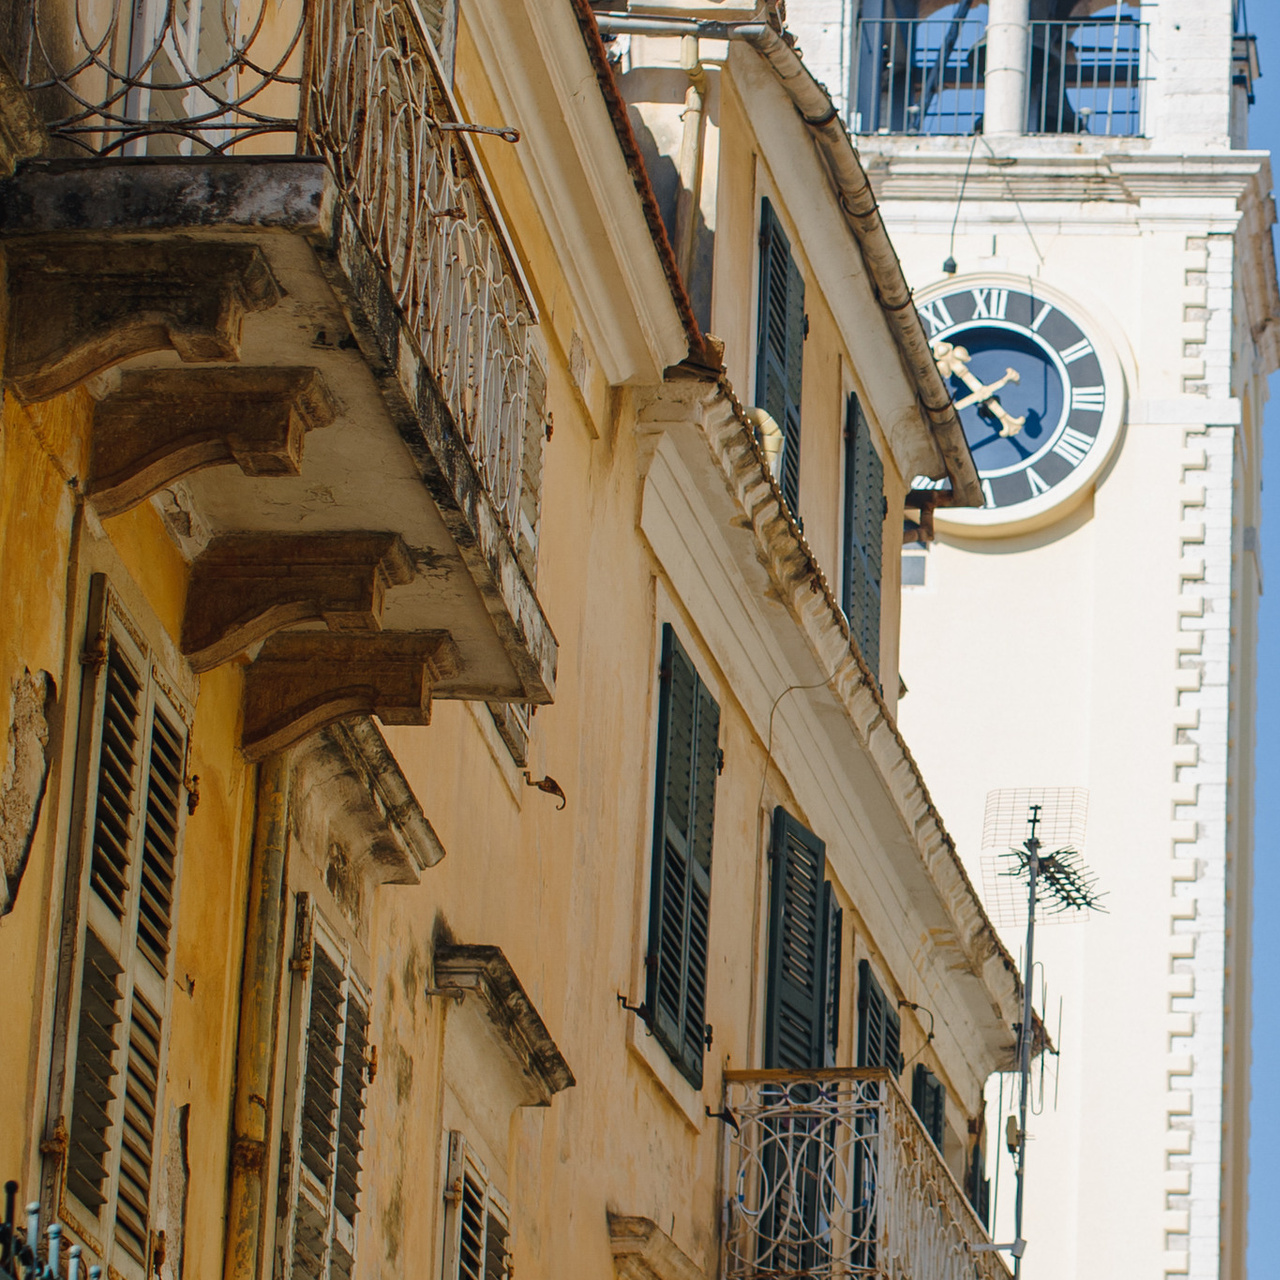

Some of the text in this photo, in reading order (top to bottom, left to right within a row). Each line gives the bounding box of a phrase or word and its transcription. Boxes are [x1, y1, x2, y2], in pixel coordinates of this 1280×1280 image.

[918, 298, 955, 336] XI
[971, 289, 1008, 320] XII
[1031, 302, 1053, 333] I
[1059, 338, 1094, 365] II
[1072, 385, 1104, 412] III
[1026, 466, 1051, 498] V
